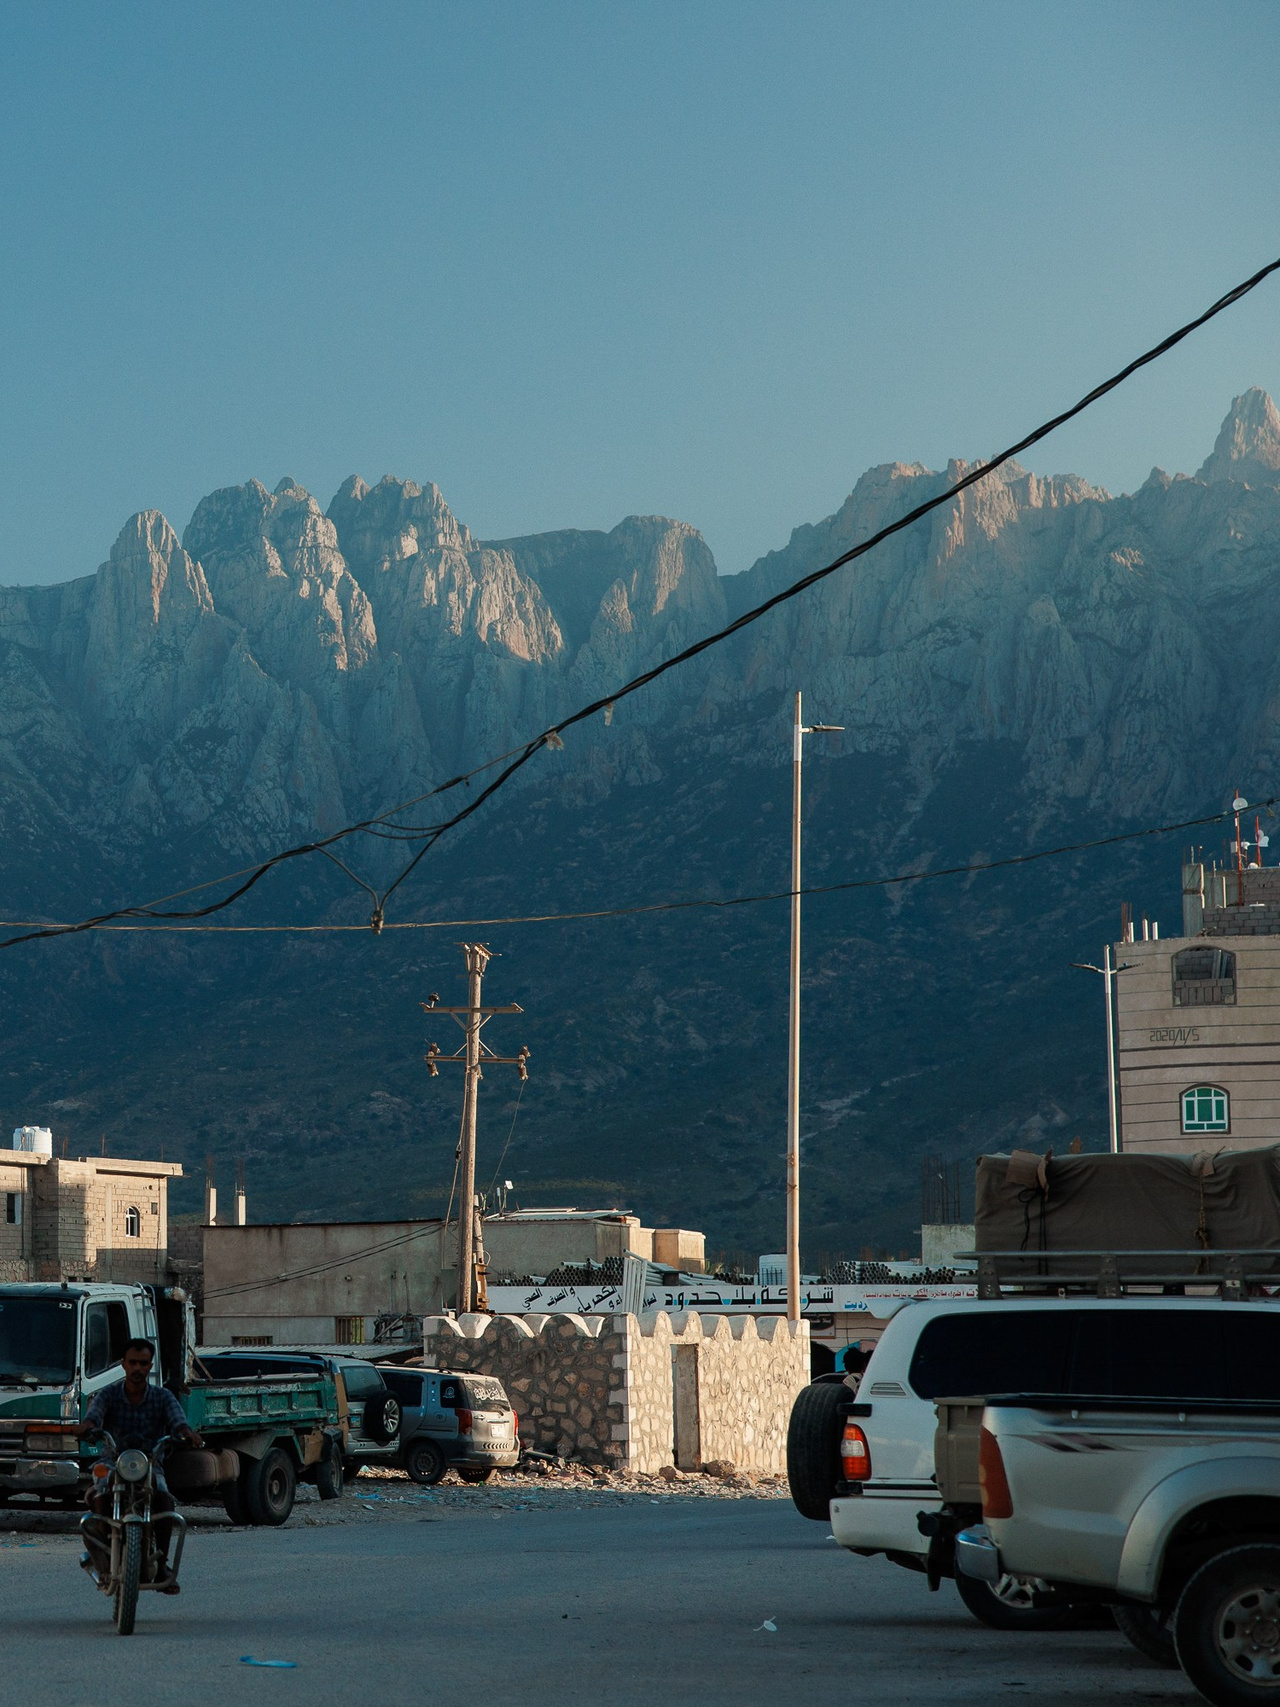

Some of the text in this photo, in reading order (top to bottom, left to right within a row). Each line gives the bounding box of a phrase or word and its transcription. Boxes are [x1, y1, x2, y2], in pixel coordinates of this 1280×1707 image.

[521, 1287, 543, 1311] الصحي
[577, 1285, 618, 1314] الكهرباء
[665, 1291, 725, 1312] حدود
[761, 1285, 834, 1312] شركة
